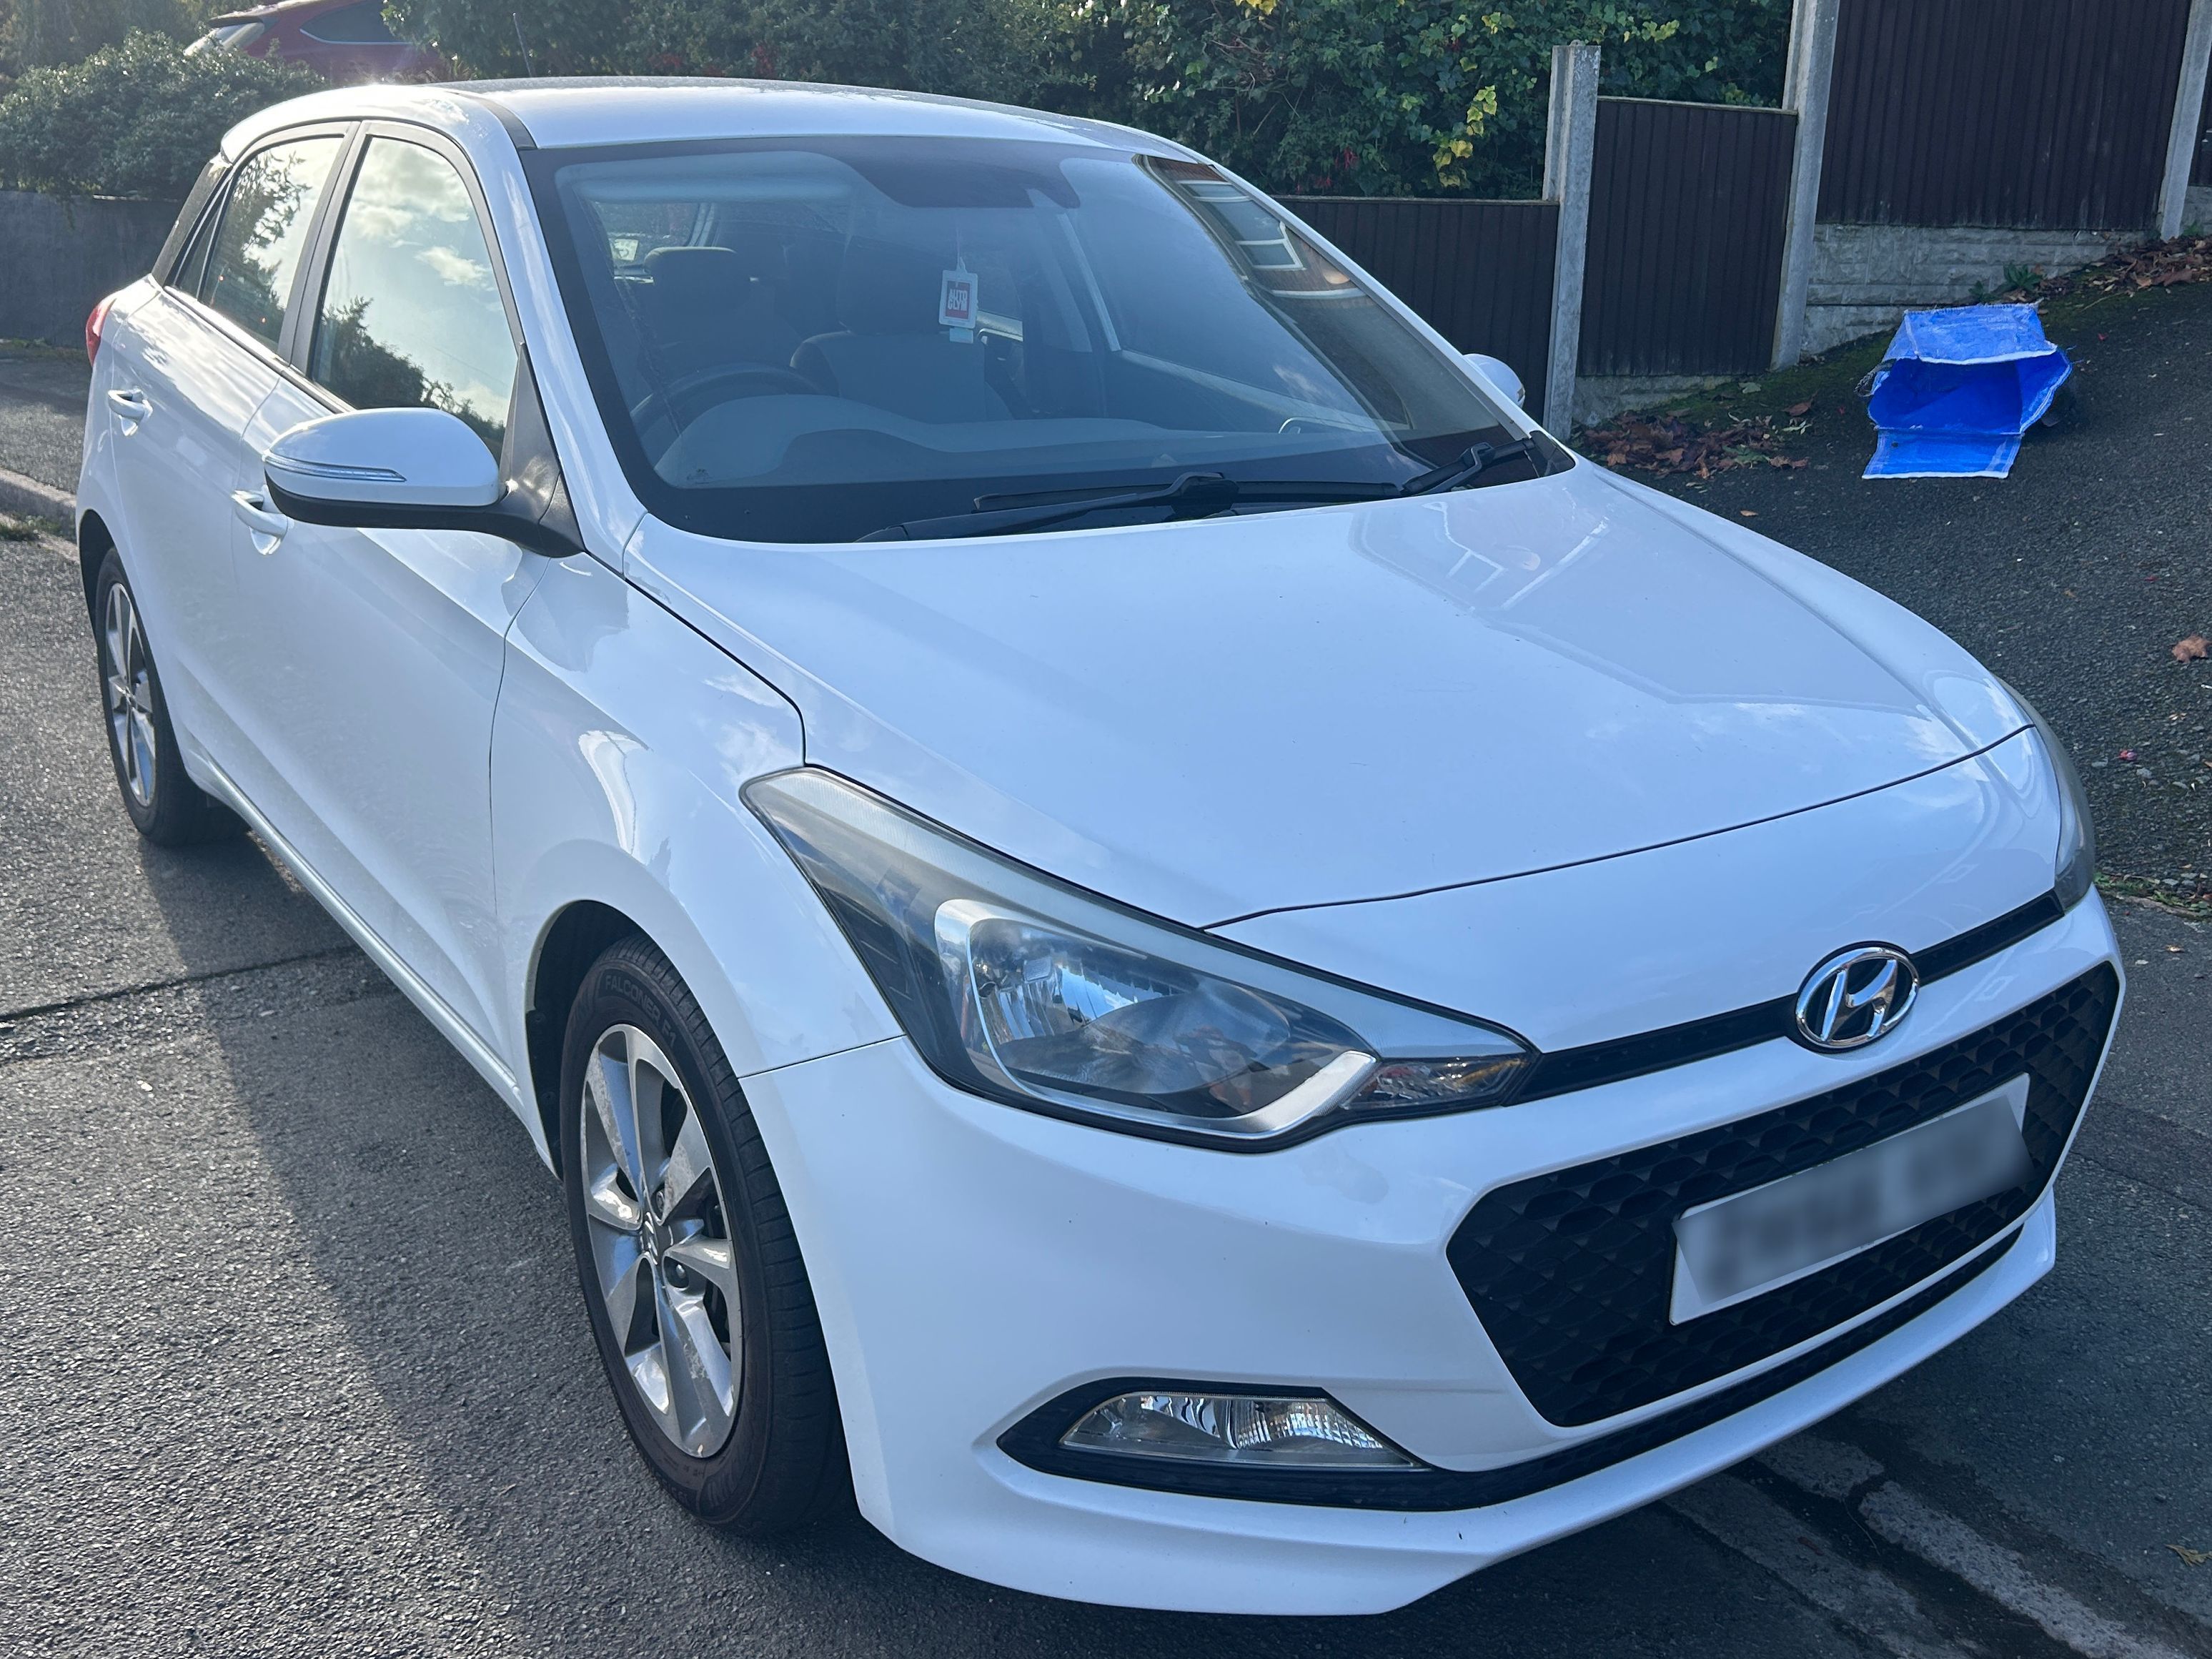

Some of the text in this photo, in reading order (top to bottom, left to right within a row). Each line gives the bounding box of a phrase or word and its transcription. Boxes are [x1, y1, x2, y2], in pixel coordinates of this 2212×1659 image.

[949, 289, 968, 301] AUTO
[948, 299, 967, 311] GLYM
[605, 975, 677, 1047] FALCONER F1
